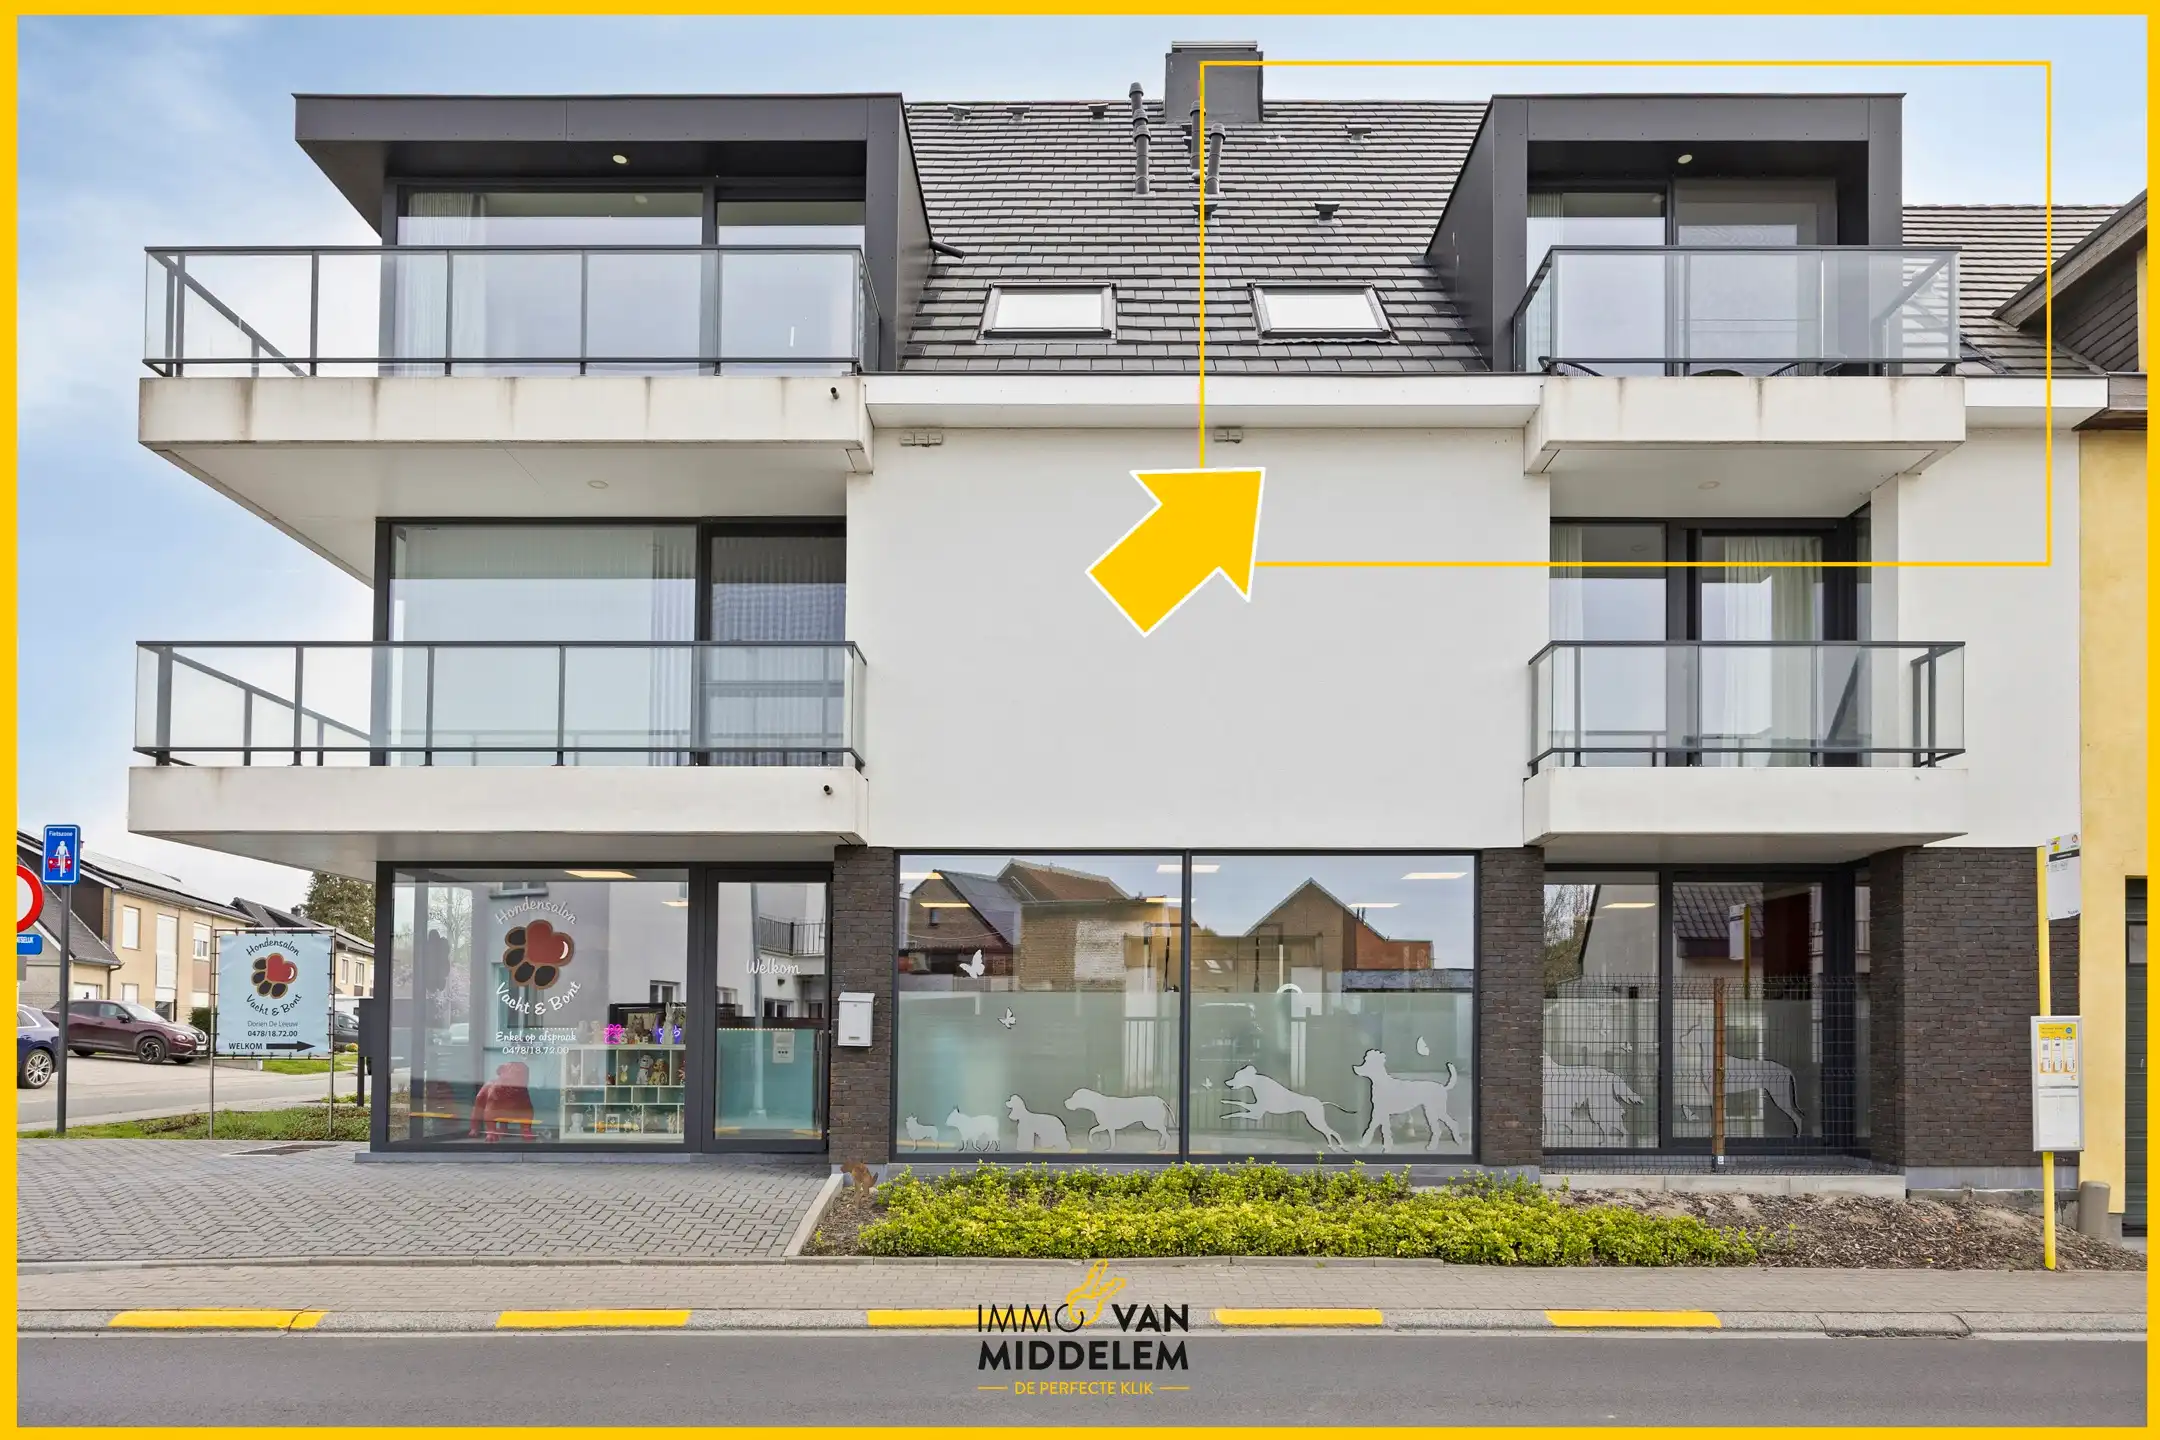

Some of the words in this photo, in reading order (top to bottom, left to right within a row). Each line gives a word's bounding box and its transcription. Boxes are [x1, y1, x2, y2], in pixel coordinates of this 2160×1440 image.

[495, 896, 577, 925] Hondensalon
[246, 937, 300, 956] Hondensalon
[746, 958, 801, 974] Welkom
[246, 994, 268, 1015] Vacht
[272, 1007, 280, 1016] &
[280, 994, 302, 1013] Bont
[495, 981, 530, 1014] Vacht
[534, 1002, 546, 1015] &
[548, 981, 581, 1011] Bont
[495, 1031, 523, 1042] Enkel
[525, 1033, 535, 1045] op
[538, 1030, 576, 1044] afspraak
[502, 1046, 569, 1055] 0478/18.72.00
